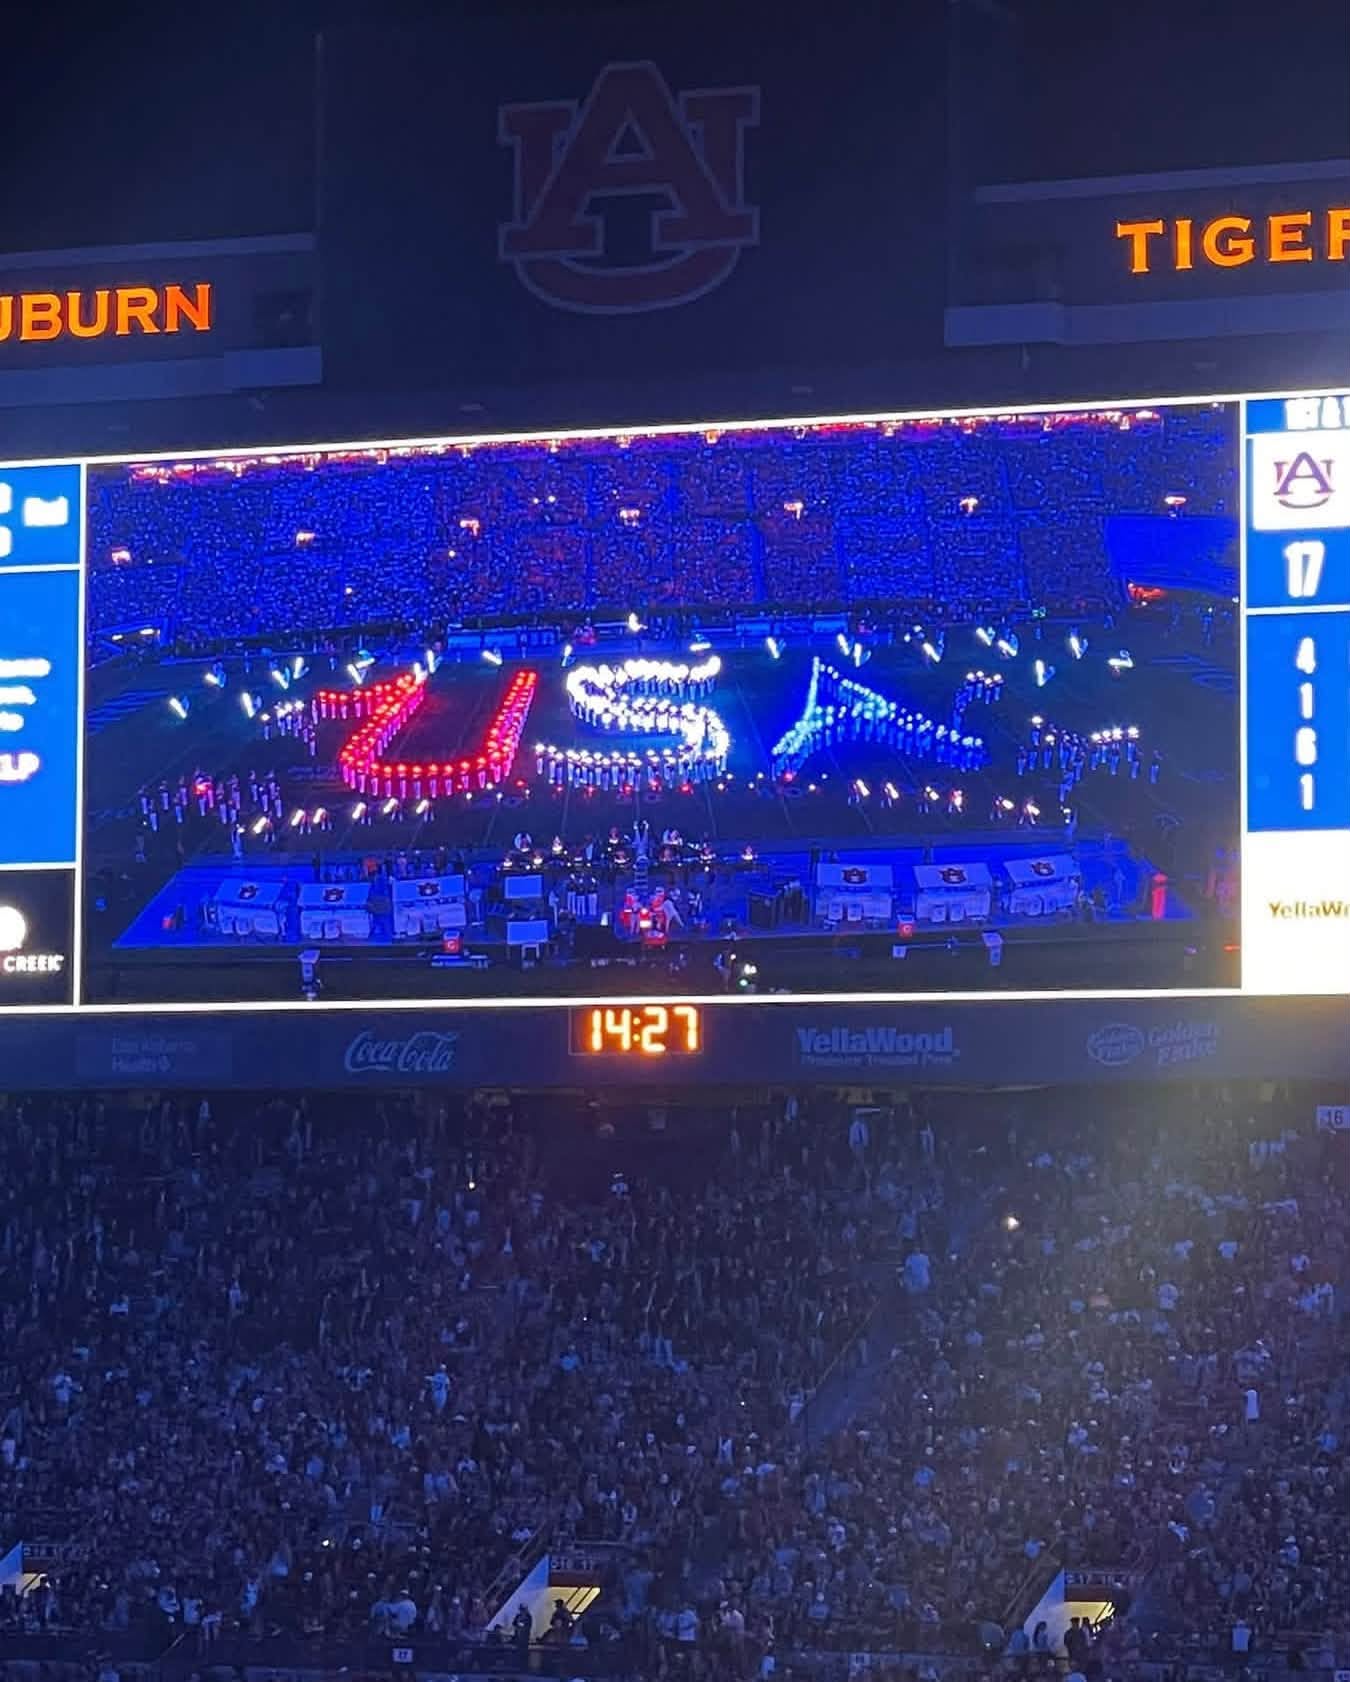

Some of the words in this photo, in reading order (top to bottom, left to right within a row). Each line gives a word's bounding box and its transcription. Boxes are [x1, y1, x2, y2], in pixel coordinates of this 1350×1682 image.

[1284, 540, 1325, 598] 17
[1296, 637, 1316, 674] 4
[1300, 682, 1313, 719] 1
[1300, 773, 1313, 810] 1
[592, 1006, 698, 1052] 14:27
[796, 1026, 953, 1053] YellaWood
